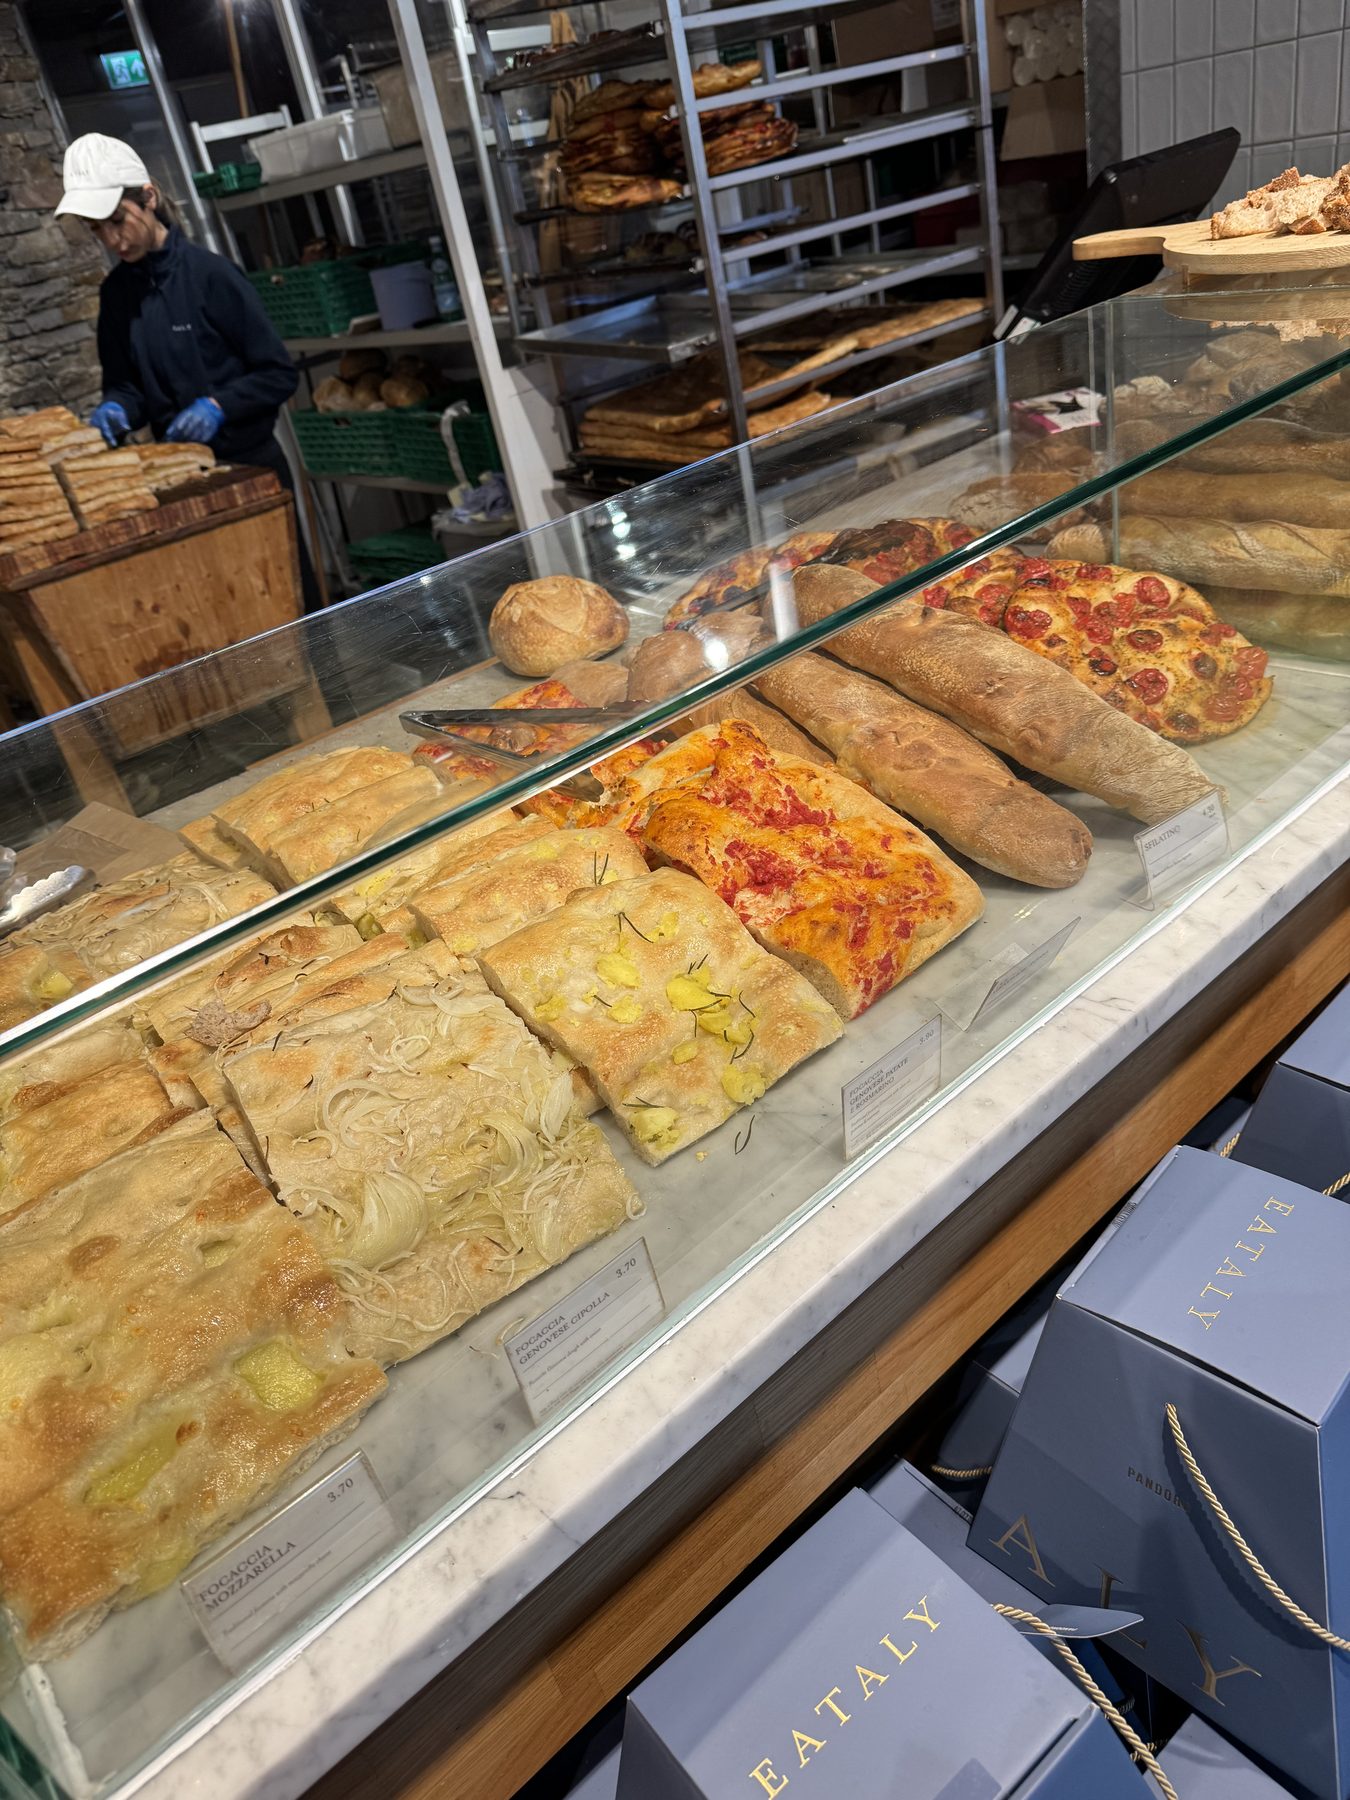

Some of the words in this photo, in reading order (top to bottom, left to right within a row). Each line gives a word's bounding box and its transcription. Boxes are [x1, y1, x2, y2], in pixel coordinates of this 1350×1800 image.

[1144, 825, 1181, 851] SFILATINO
[850, 1069, 884, 1098] FOCACCIA
[850, 1075, 886, 1105] GENOVESE
[615, 1257, 637, 1279] 3.70
[1188, 1196, 1295, 1331] EATALY
[514, 1315, 566, 1356] FOCACCIA
[519, 1322, 570, 1365] GENOVESE
[571, 1292, 610, 1325] CIPOLLA
[326, 1478, 354, 1503] 3.70
[1127, 1466, 1192, 1512] PANDOR
[199, 1545, 272, 1602] FOCACCIA
[205, 1541, 297, 1613] MOZZARELLA
[749, 1595, 942, 1800] EATALY
